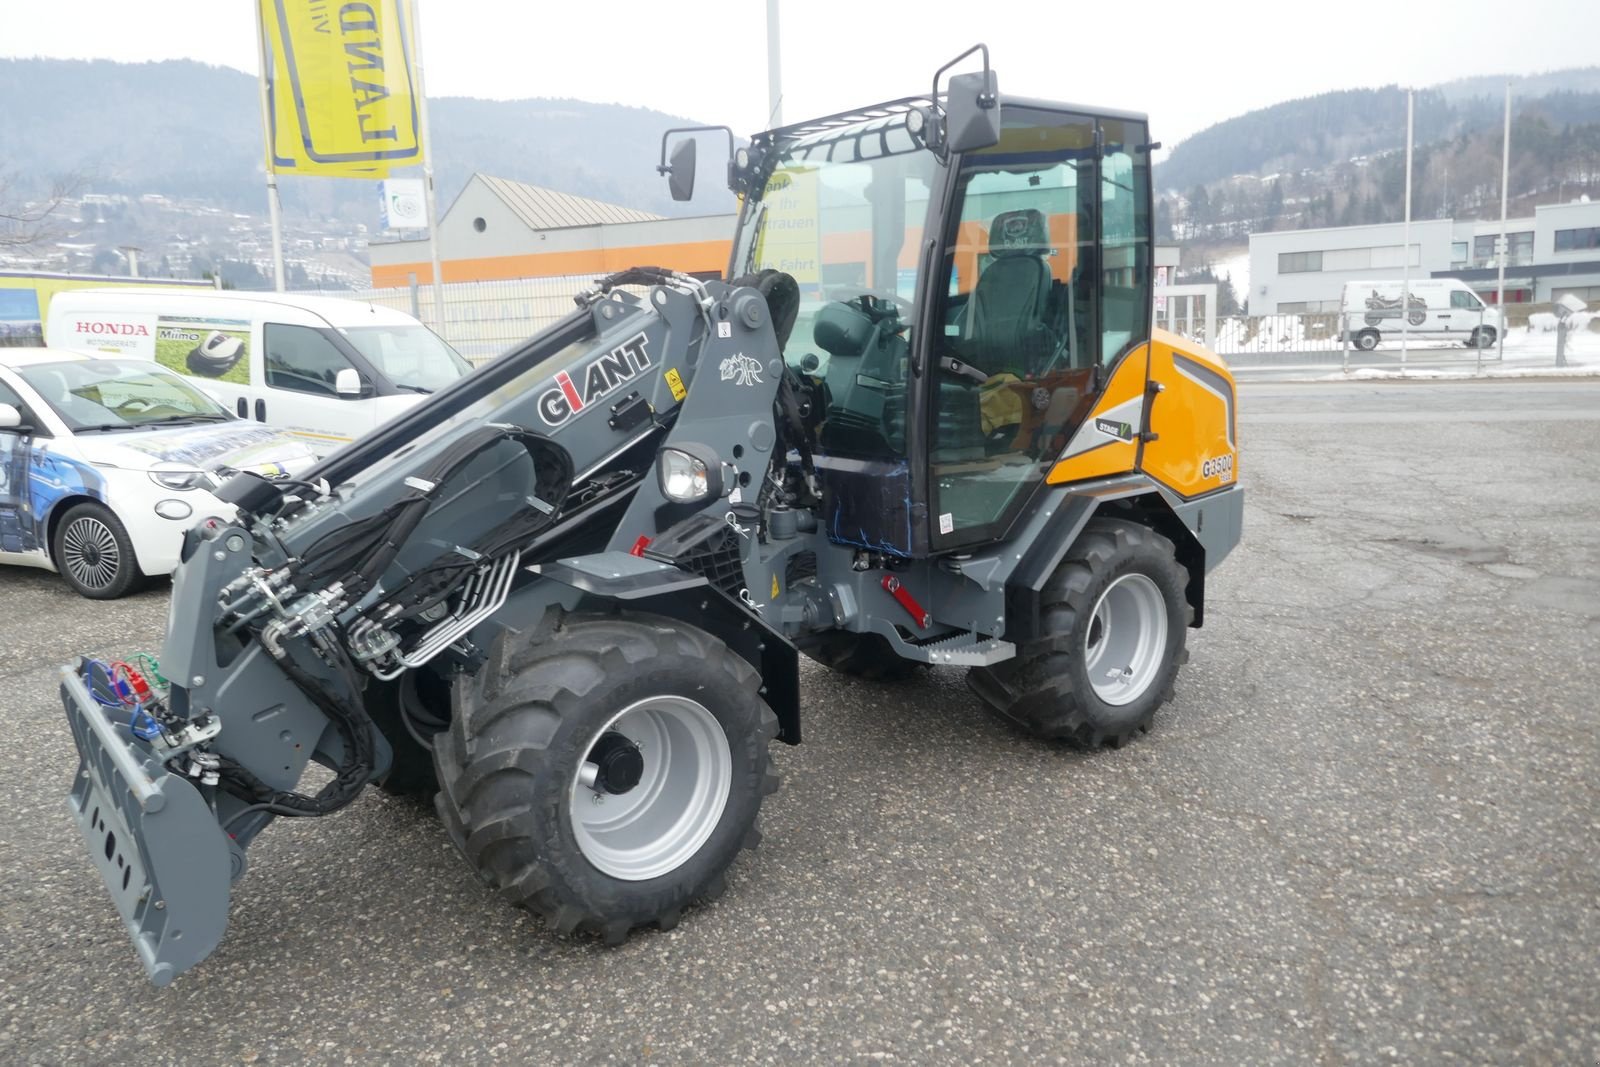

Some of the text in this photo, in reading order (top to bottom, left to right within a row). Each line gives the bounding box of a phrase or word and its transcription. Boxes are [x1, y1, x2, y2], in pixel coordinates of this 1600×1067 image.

[780, 258, 815, 271] Fahrt
[76, 322, 149, 336] HONDA
[160, 330, 200, 341] Miimo
[1099, 422, 1130, 437] STAGE V
[1202, 454, 1232, 478] G3500
